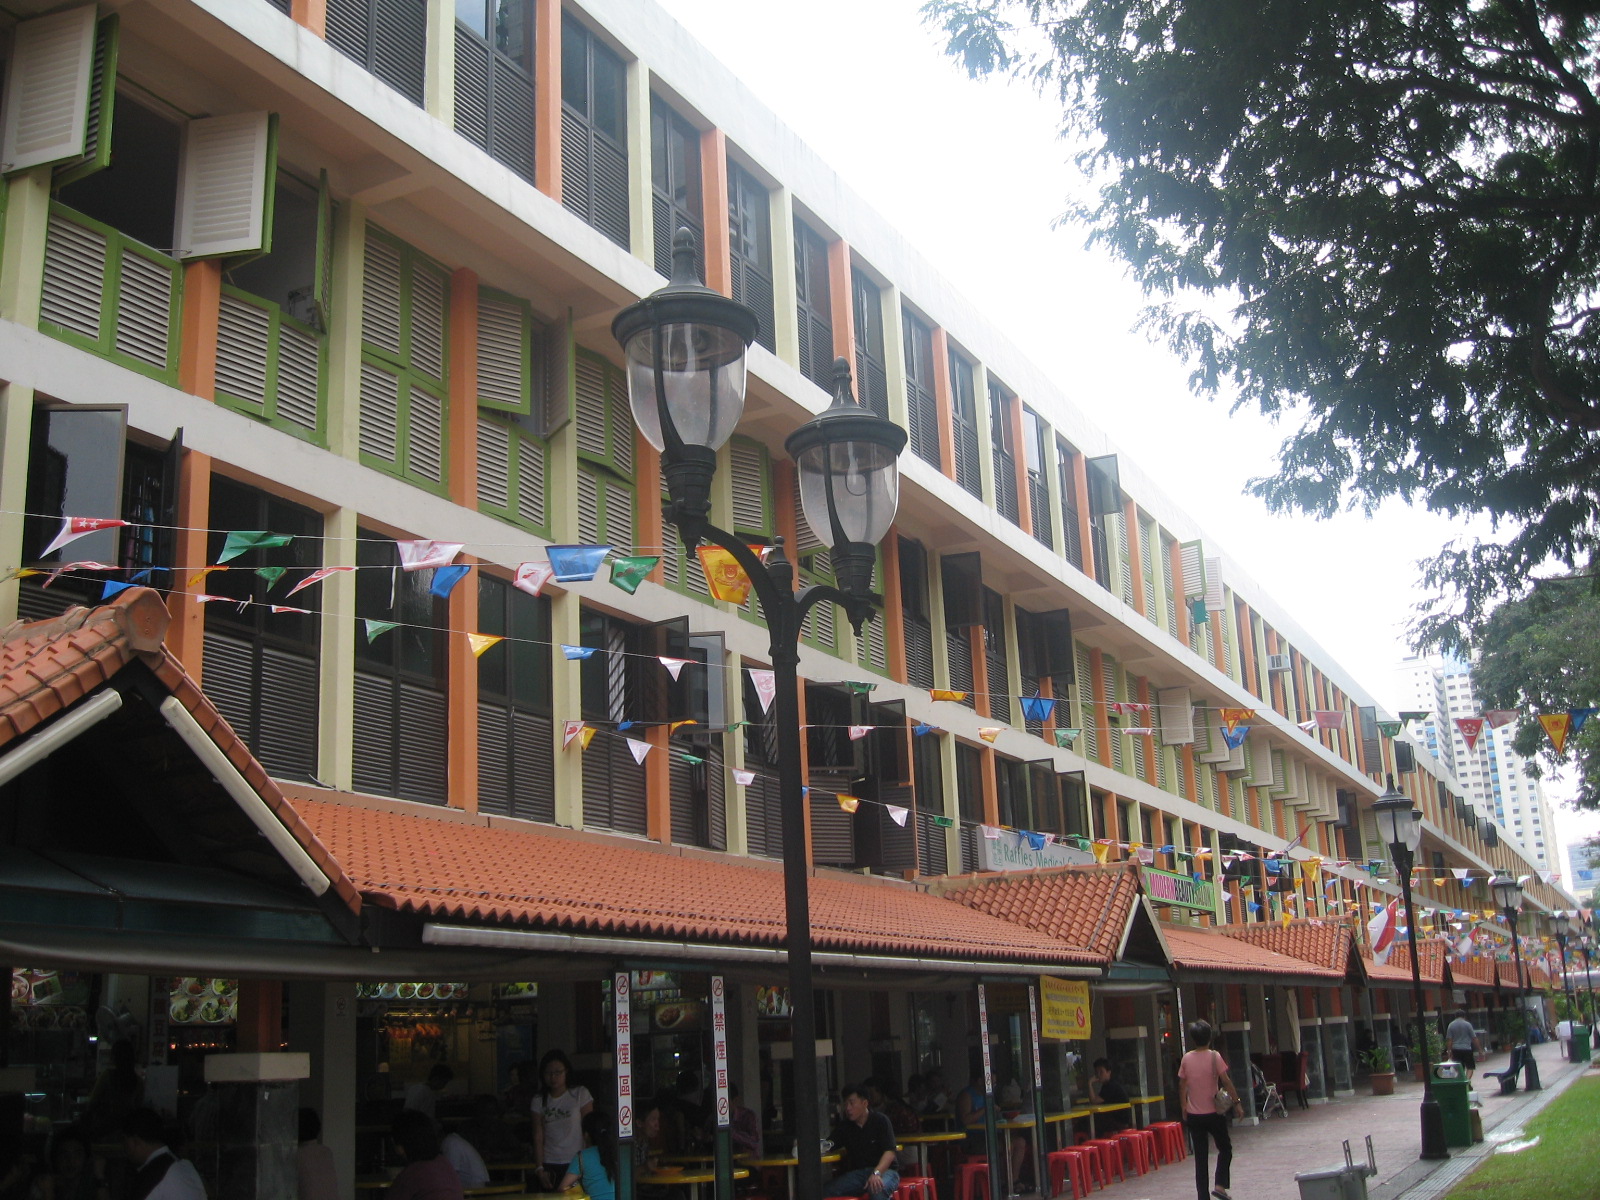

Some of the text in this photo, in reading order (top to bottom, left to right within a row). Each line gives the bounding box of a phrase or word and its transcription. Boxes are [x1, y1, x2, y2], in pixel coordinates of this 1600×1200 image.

[1003, 843, 1033, 867] Raffles
[1150, 872, 1176, 901] MODERN
[617, 1012, 631, 1096] 禁煙區
